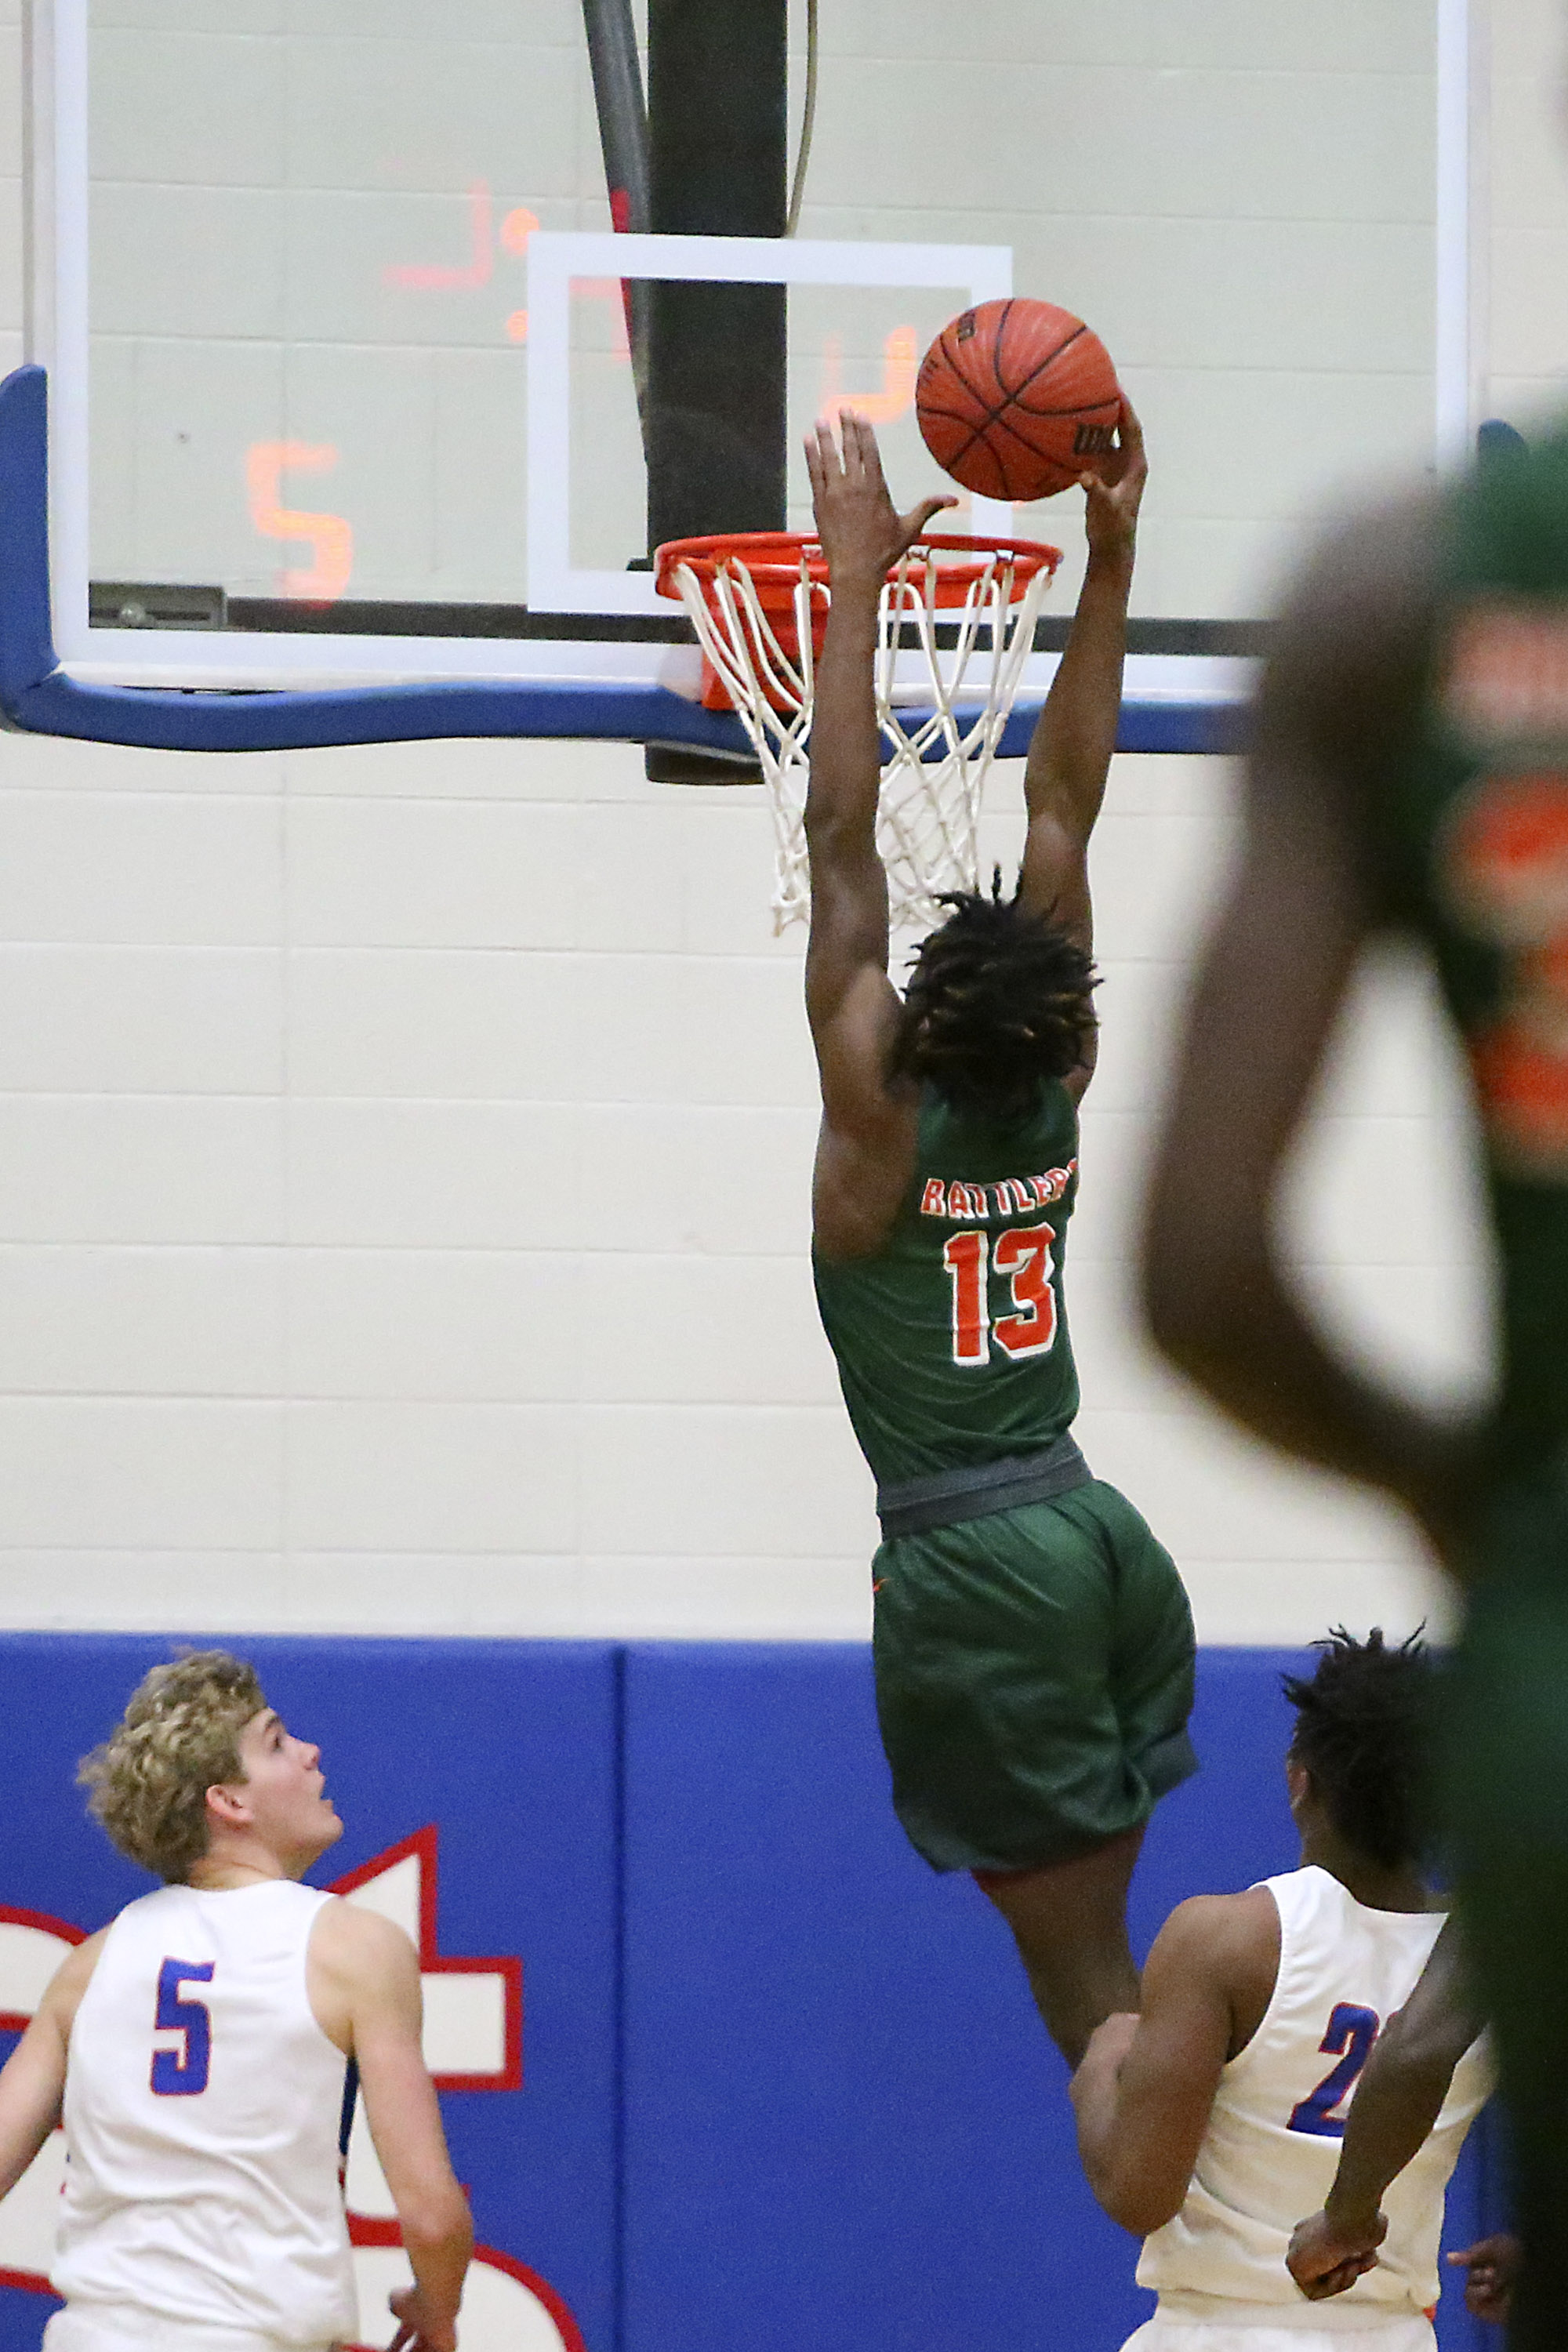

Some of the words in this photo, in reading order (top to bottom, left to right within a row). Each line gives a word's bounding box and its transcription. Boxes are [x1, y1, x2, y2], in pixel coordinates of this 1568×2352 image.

[943, 1221, 1058, 1367] 13
[150, 1955, 216, 2096] 5
[1287, 2002, 1402, 2138] 2
